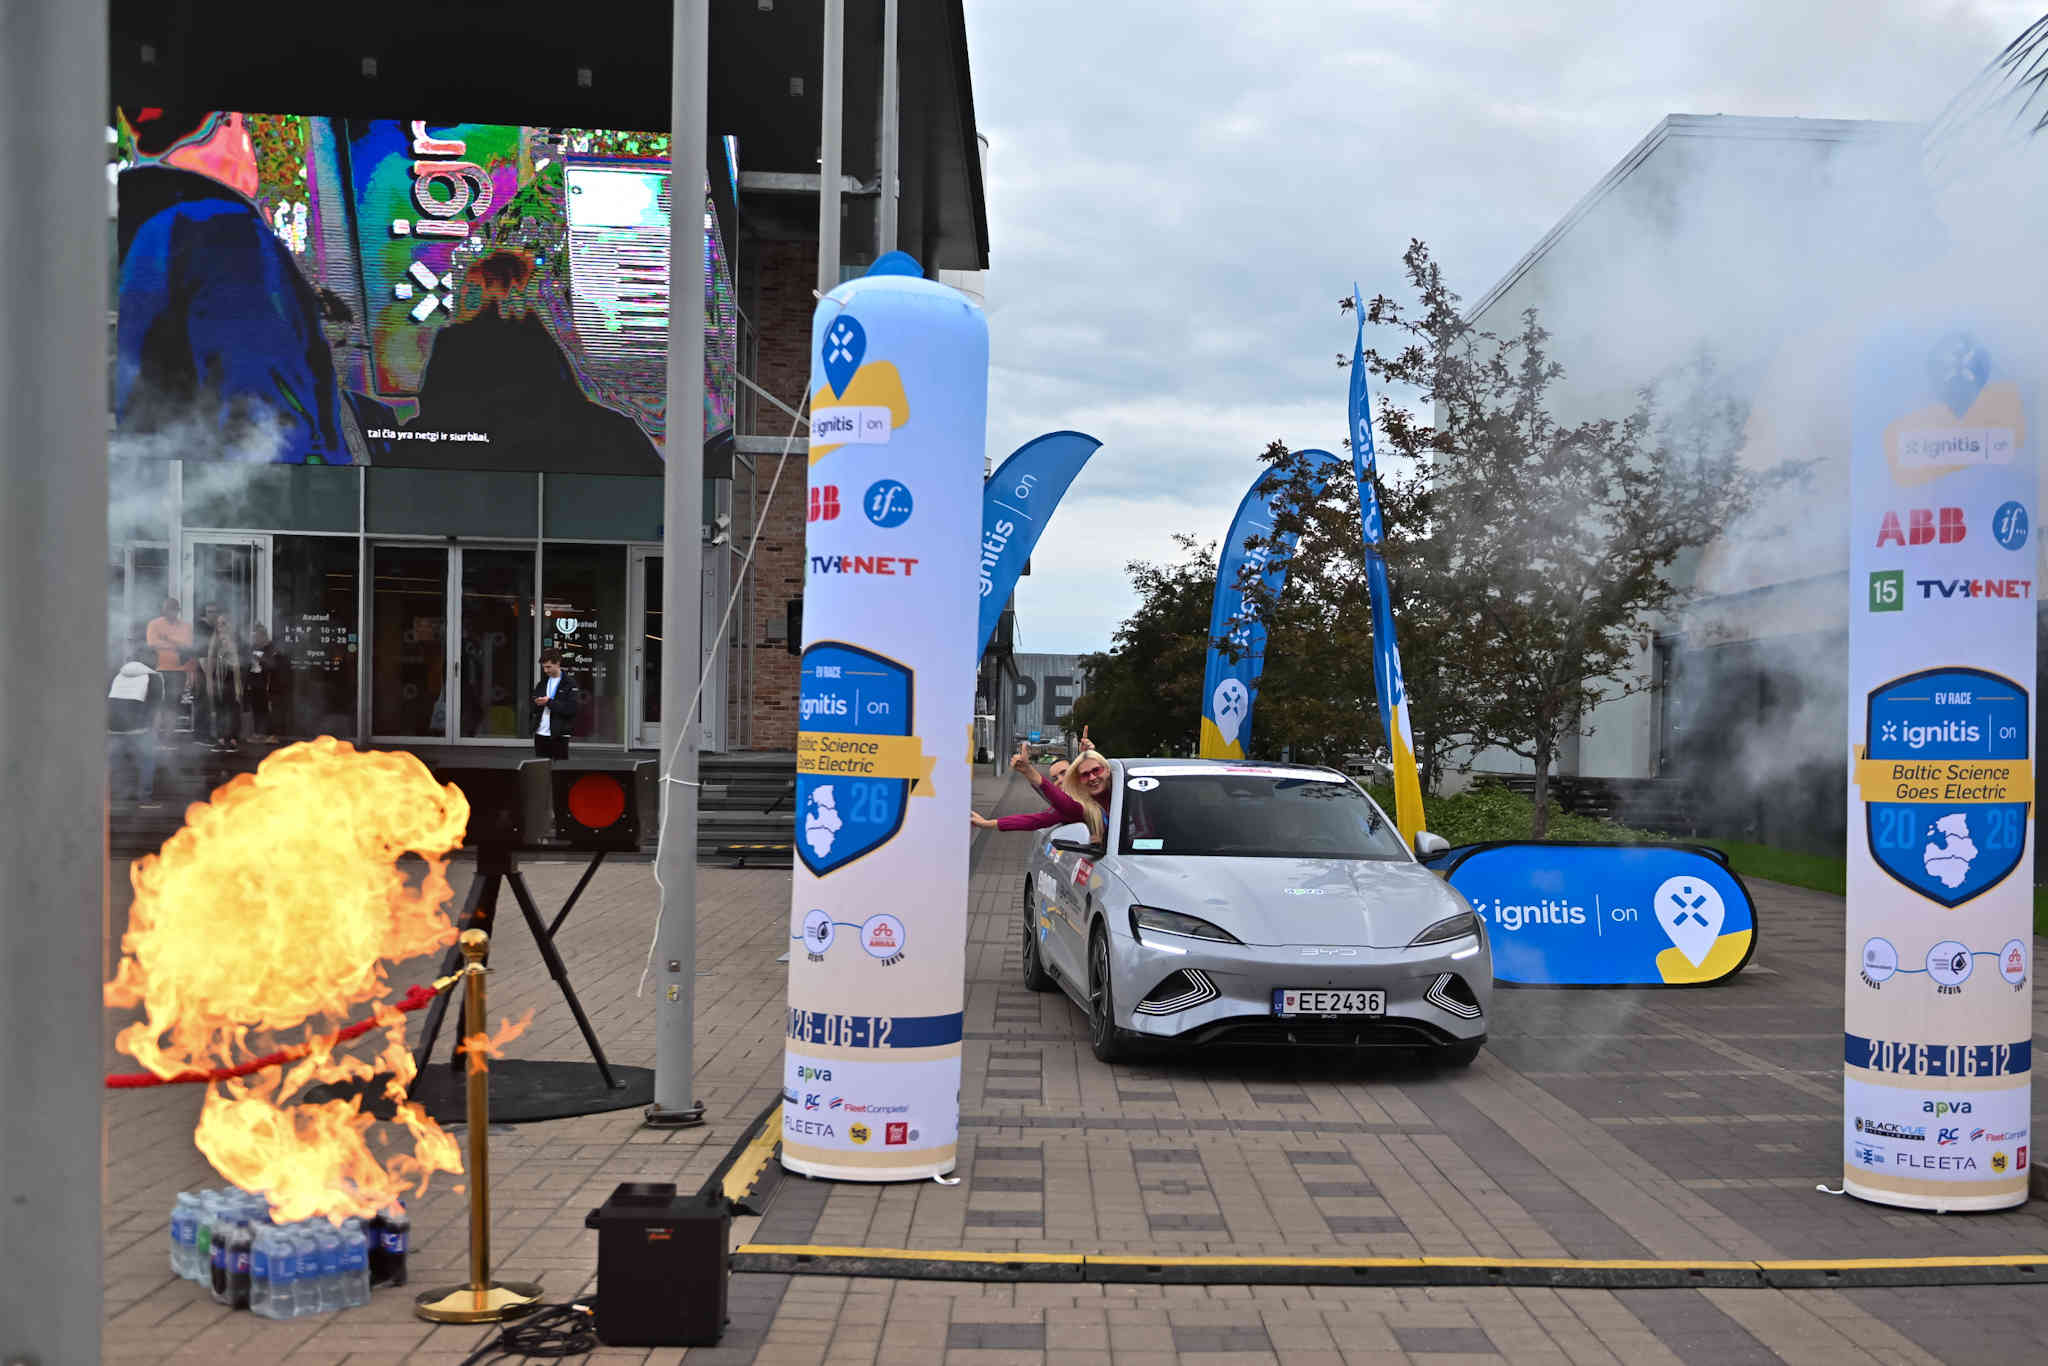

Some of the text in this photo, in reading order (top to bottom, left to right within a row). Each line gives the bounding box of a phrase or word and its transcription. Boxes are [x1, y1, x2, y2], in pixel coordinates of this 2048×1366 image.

[866, 419, 883, 430] on
[367, 429, 381, 438] tai
[397, 431, 413, 441] yra
[1015, 474, 1037, 499] on
[806, 485, 841, 522] BB
[1876, 507, 1967, 548] ABB
[979, 520, 1014, 597] gnitis
[1873, 579, 1897, 603] 15
[866, 701, 889, 714] on
[1935, 692, 1972, 705] EV RACE
[1903, 720, 2017, 749] ignitis on
[820, 737, 878, 755] Science
[818, 755, 874, 774] Electric
[1892, 764, 2010, 780] Baltic Science
[1896, 783, 2007, 800] Goes Electric
[850, 782, 889, 824] 26
[1879, 809, 2017, 849] 20 26
[1494, 898, 1638, 931] ignitis on
[1299, 992, 1379, 1011] EE2436
[1868, 1040, 2011, 1077] 2026-06-12
[798, 1065, 832, 1083] apva
[1922, 1100, 1972, 1117] apva
[1864, 1119, 1927, 1136] BLACKVUE
[1896, 1152, 1977, 1170] FLEETA
